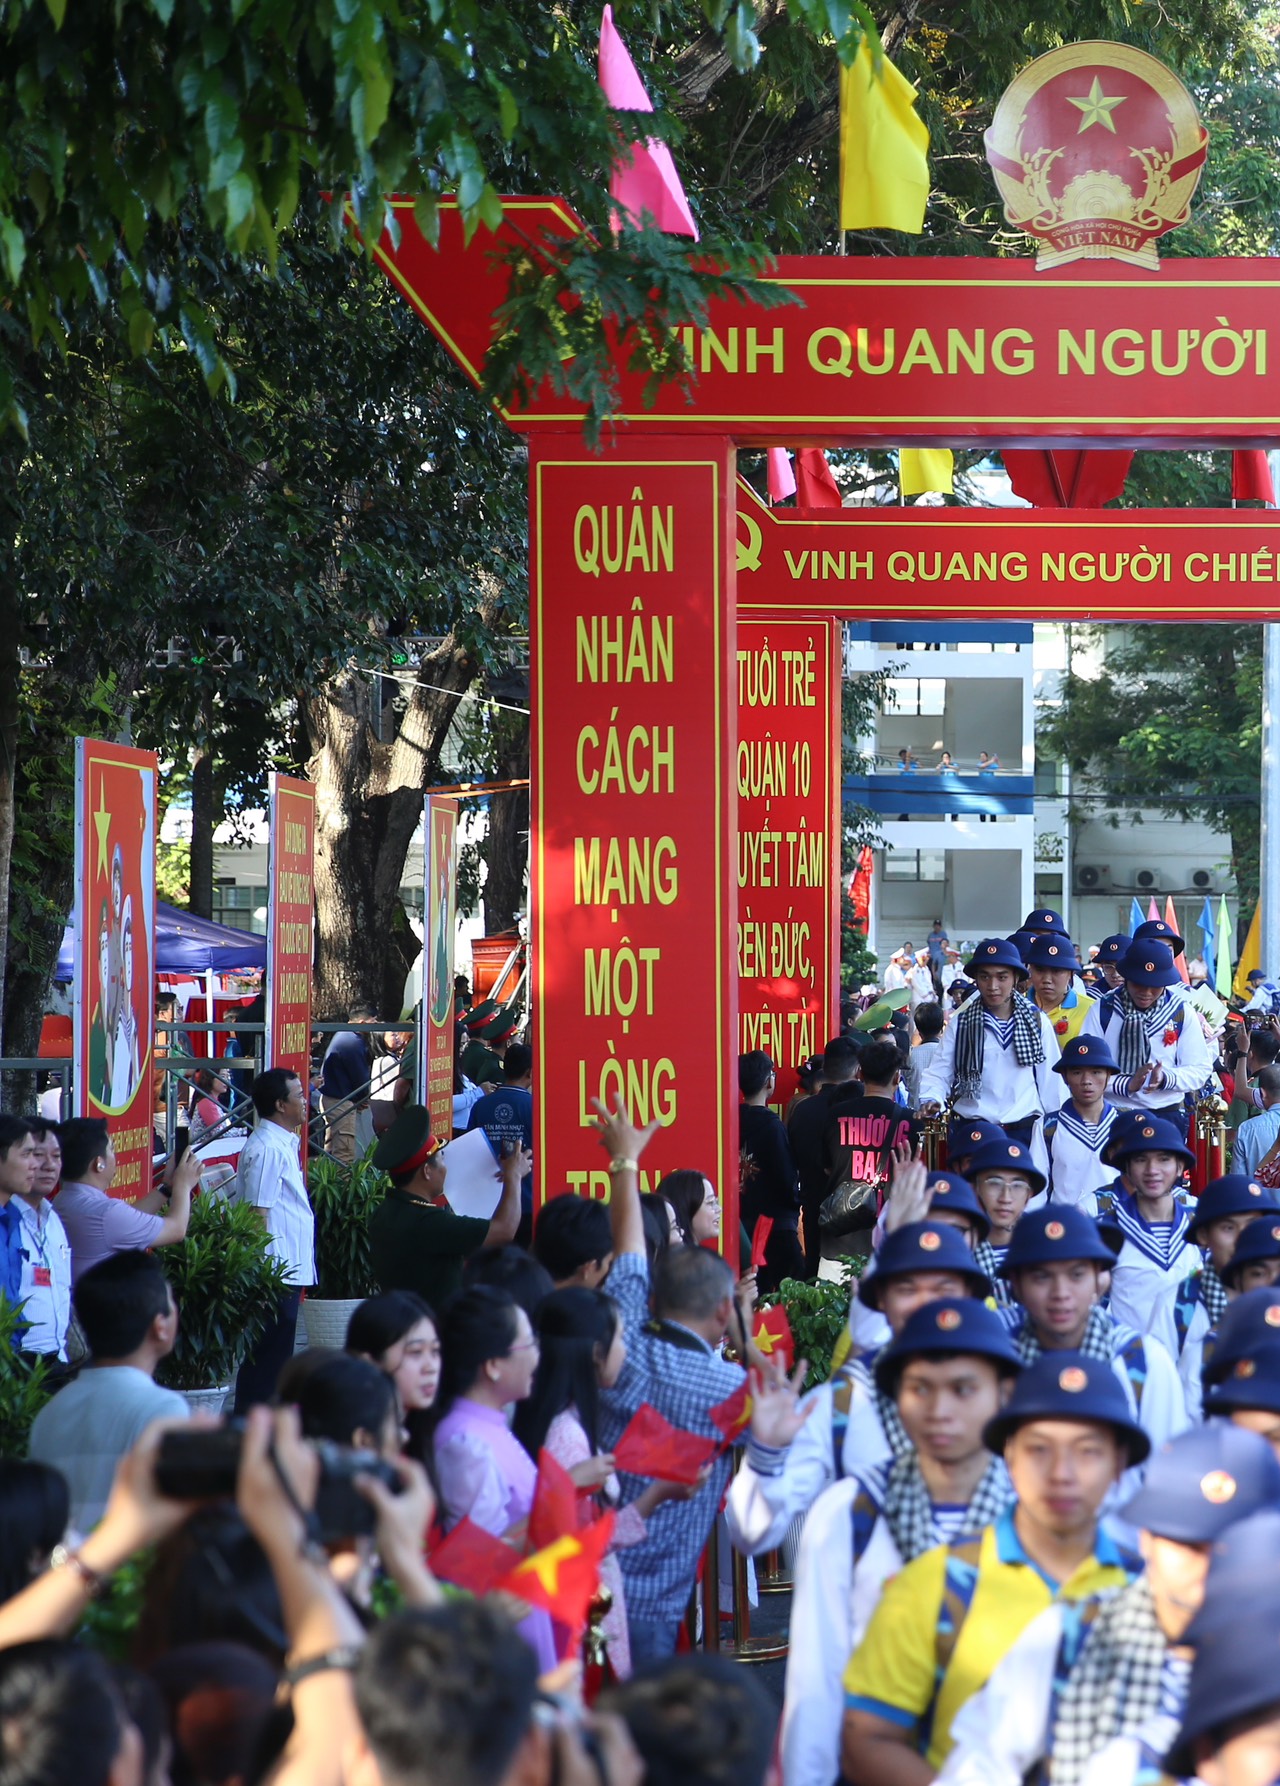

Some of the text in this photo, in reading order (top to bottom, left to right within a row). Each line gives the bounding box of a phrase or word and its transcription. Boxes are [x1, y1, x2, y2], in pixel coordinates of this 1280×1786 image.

[1057, 231, 1138, 250] VIỆT NAM
[806, 326, 1035, 378] QUANG
[1058, 316, 1268, 377] NGƯỜI
[573, 486, 674, 578] QUÂN
[783, 550, 874, 580] VINH
[887, 550, 1028, 583] QUANG
[1042, 544, 1171, 583] NGƯỜI
[576, 596, 674, 683] NHÂN
[737, 637, 816, 707] TUỔI TRẺ
[576, 706, 675, 795] CÁCH
[737, 731, 811, 812] QUẬN 10
[574, 836, 678, 924] MẠNG
[786, 816, 823, 888] TÂM
[584, 936, 661, 1034] MỘT
[771, 906, 815, 989] ĐỨC,
[788, 997, 815, 1059] TÀI
[578, 1040, 677, 1128] LÒNG
